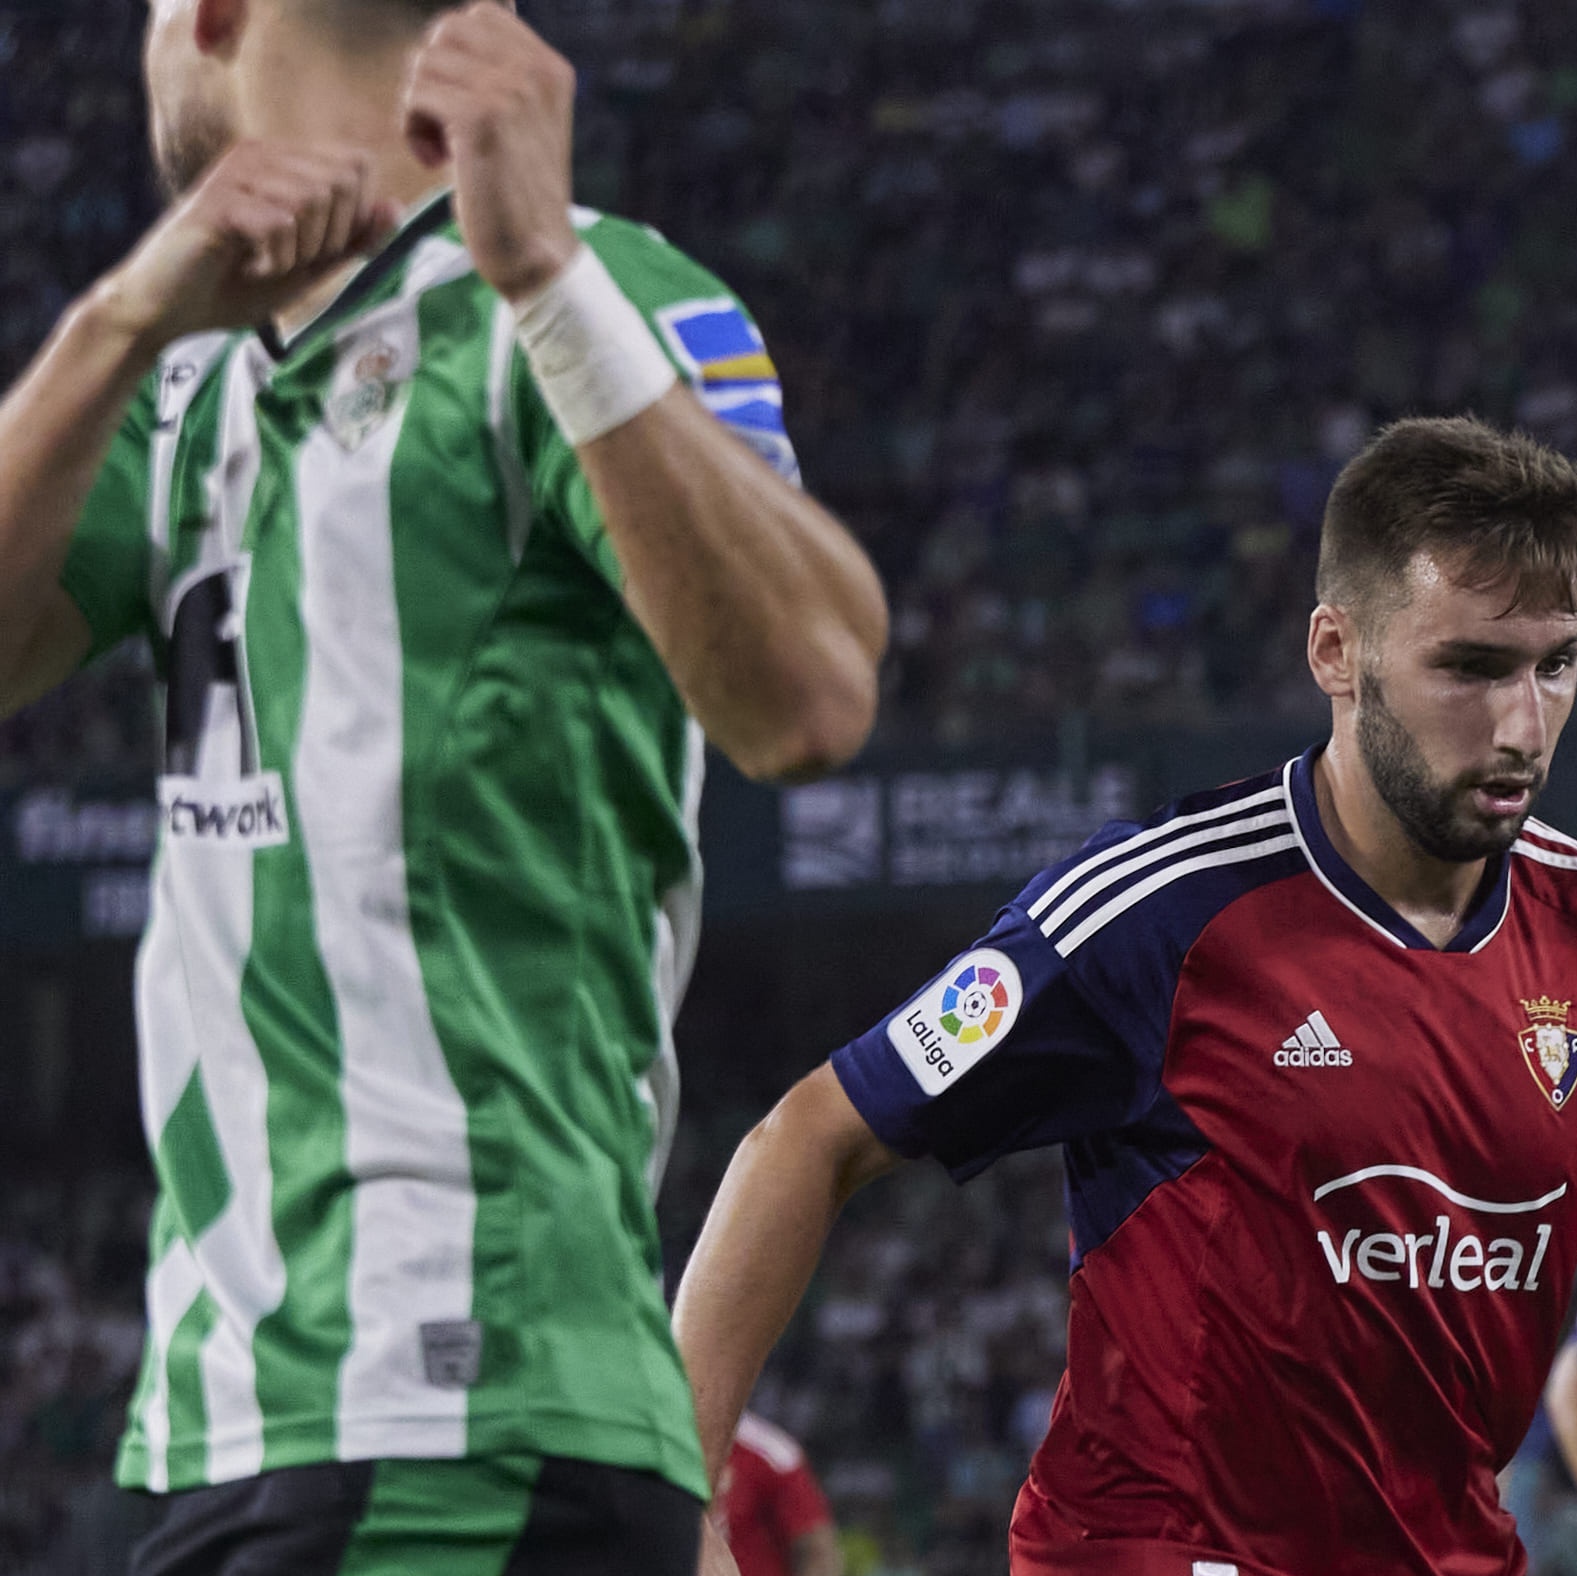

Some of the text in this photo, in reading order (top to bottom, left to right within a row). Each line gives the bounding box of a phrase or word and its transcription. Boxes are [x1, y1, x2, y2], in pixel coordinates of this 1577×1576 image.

[907, 1009, 954, 1079] LaLiga
[1273, 1046, 1353, 1067] adidas
[1317, 1215, 1552, 1292] verleal
